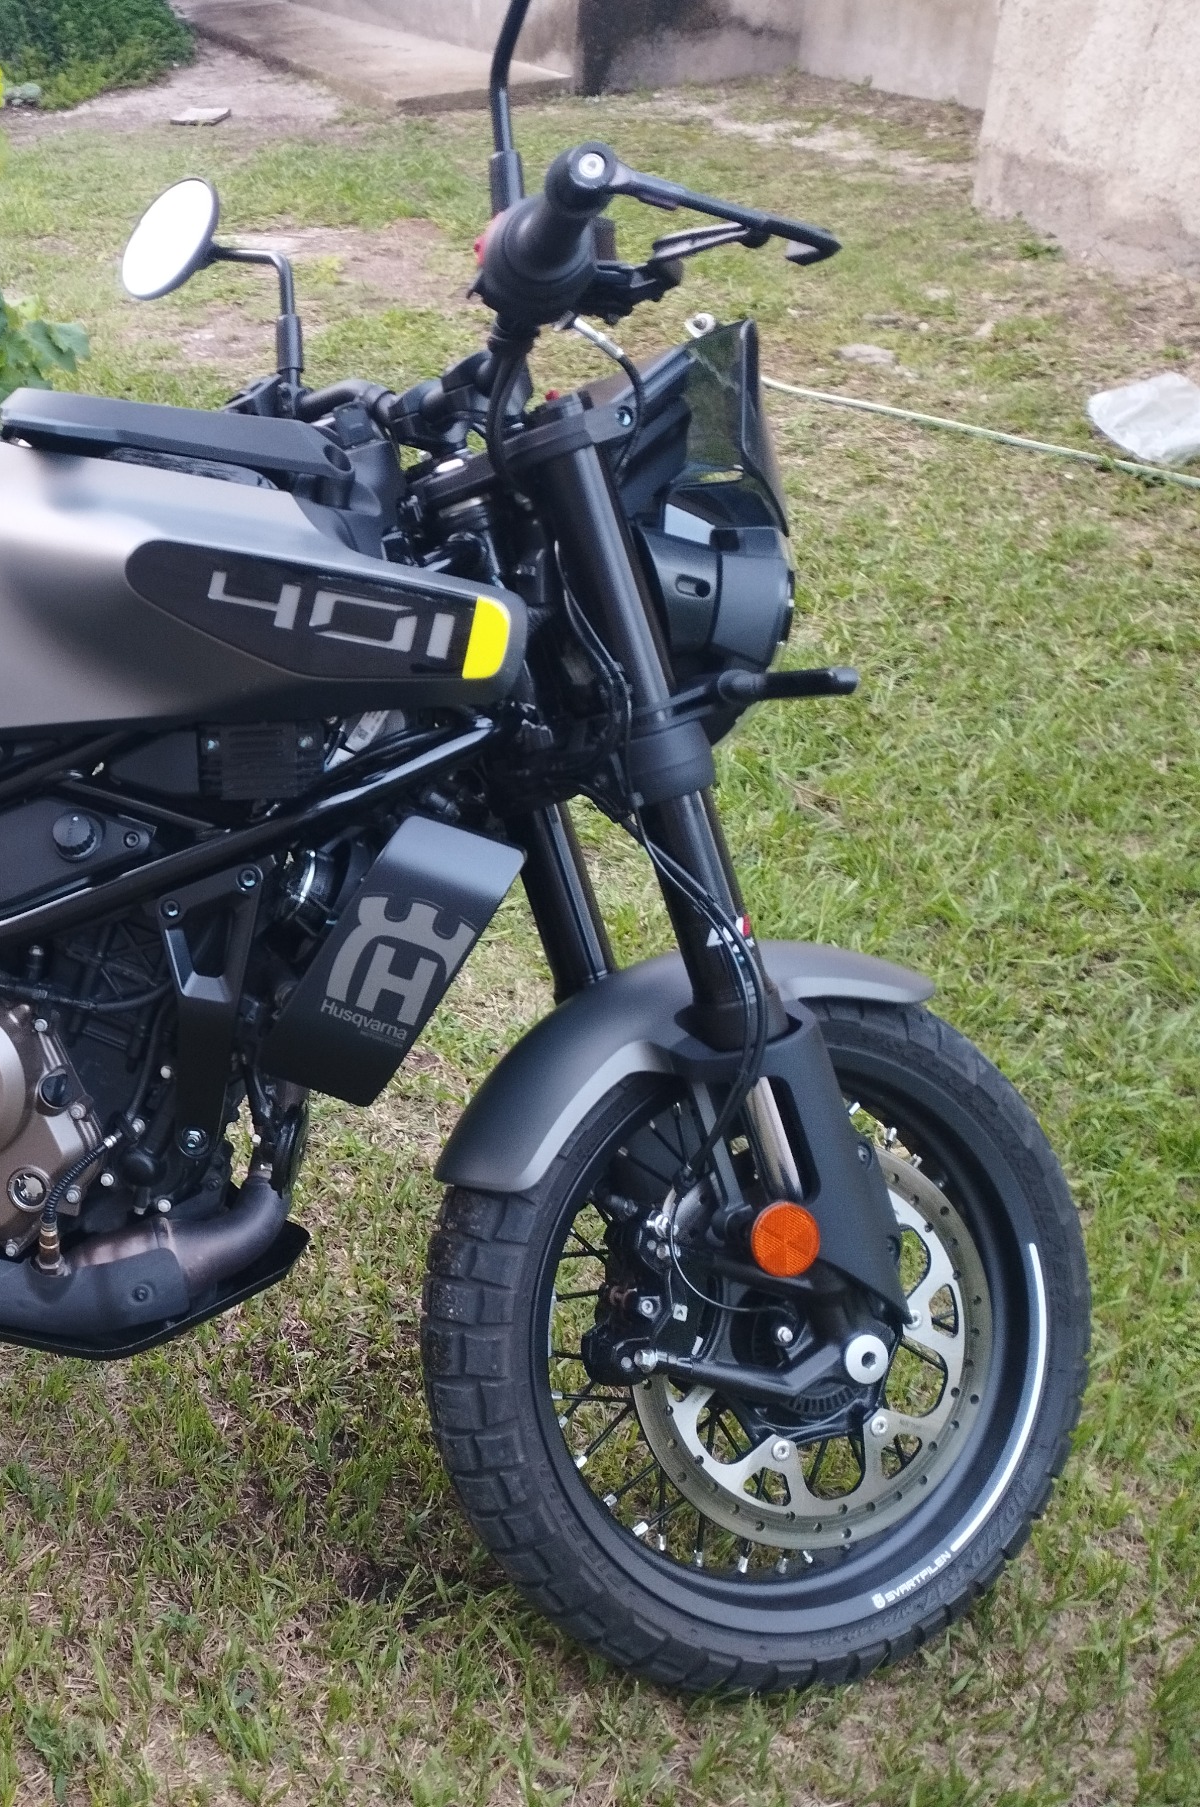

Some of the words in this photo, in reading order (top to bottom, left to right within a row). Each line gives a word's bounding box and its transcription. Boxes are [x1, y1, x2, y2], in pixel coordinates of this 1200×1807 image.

[207, 571, 456, 659] 401
[320, 999, 408, 1041] Husqvarna
[885, 1550, 952, 1603] SVARTPILEN
